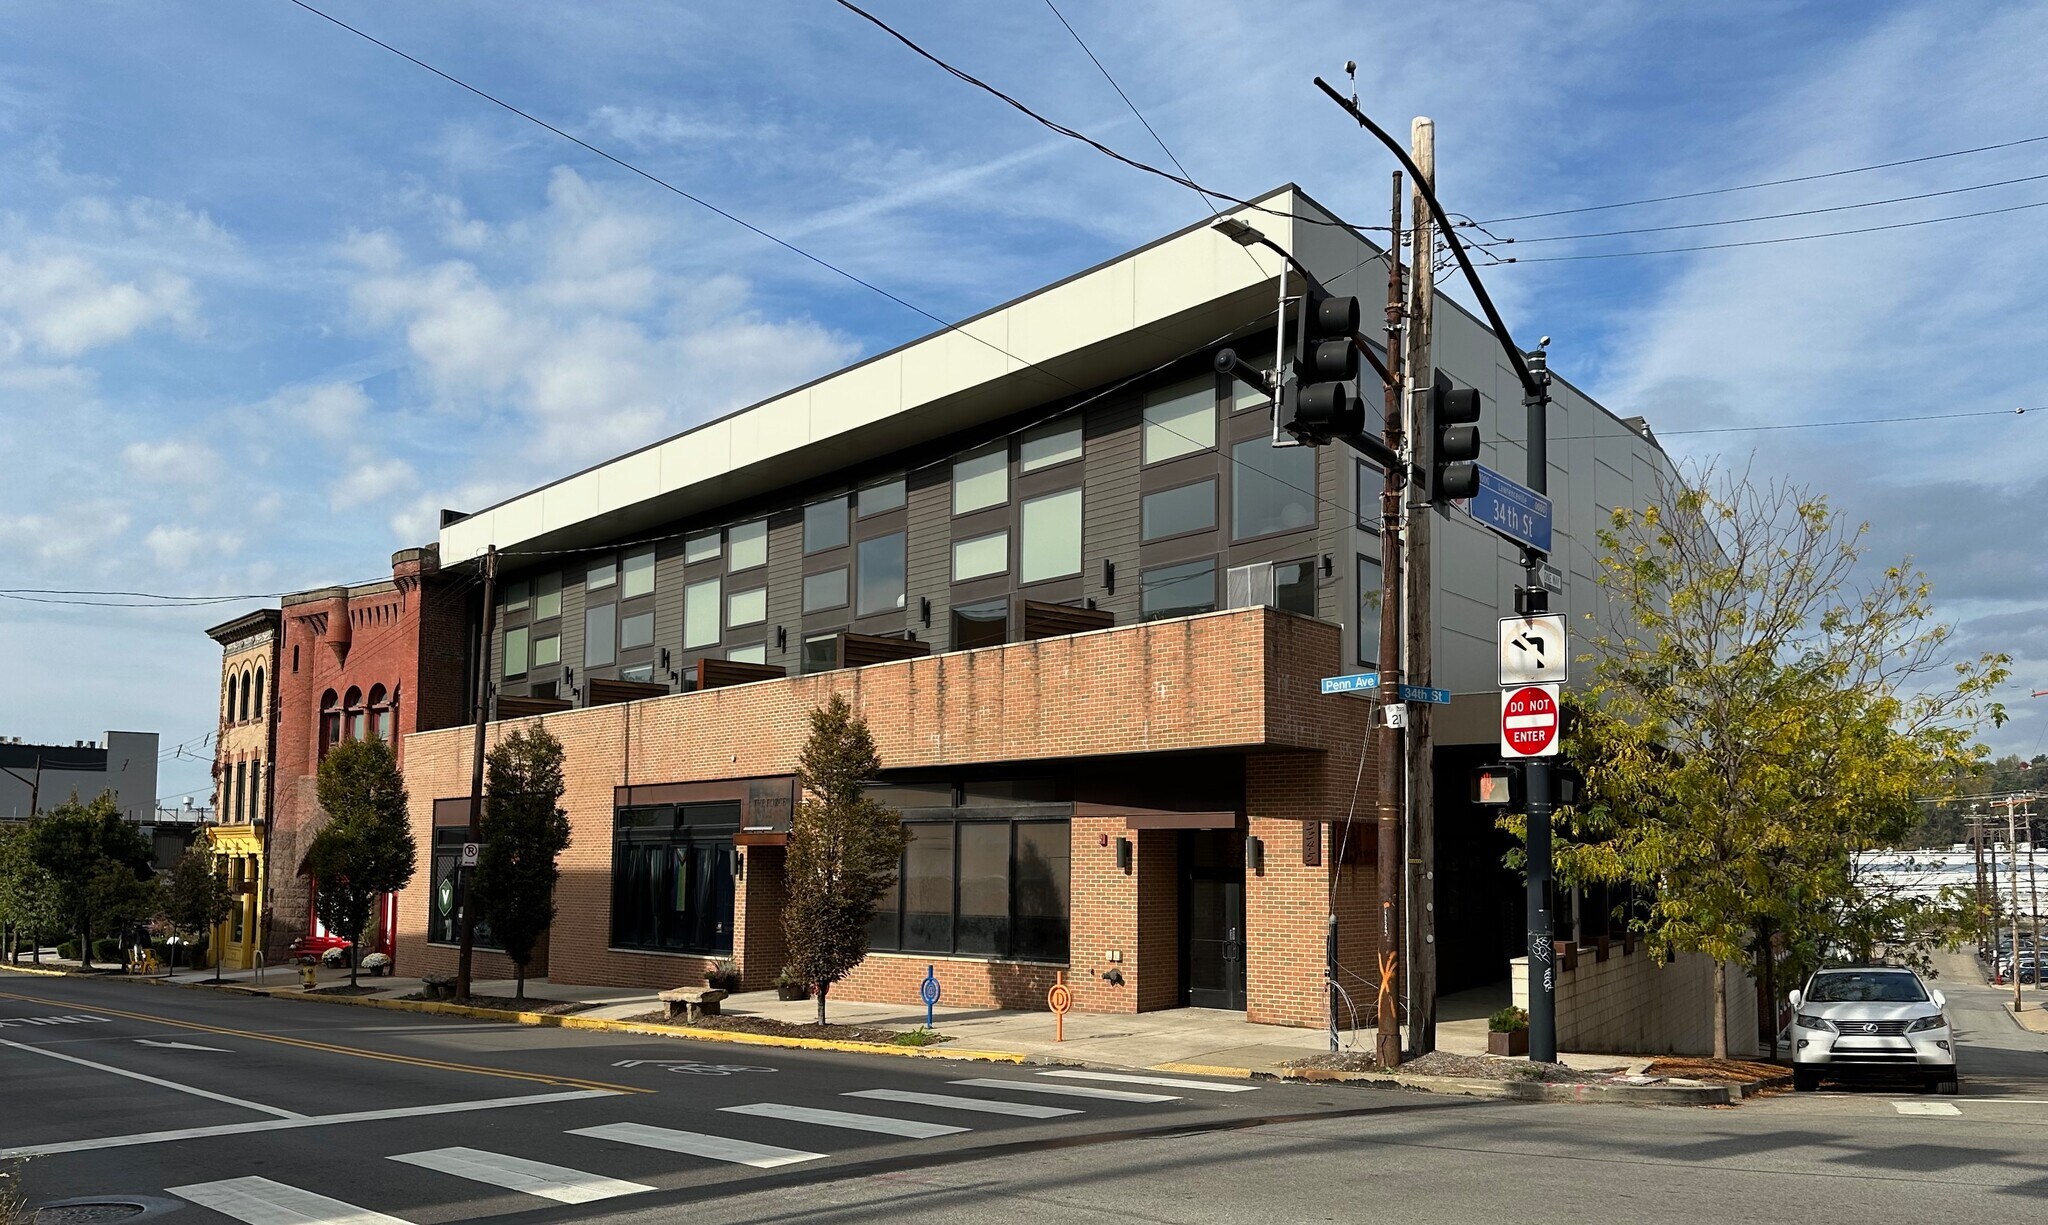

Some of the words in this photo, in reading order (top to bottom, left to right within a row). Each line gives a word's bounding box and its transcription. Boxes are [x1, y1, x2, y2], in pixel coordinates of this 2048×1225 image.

[1498, 483, 1527, 505] Lawrenceville
[1493, 499, 1518, 531] 34th
[1523, 514, 1533, 538] St
[1326, 680, 1352, 691] Penn
[1355, 677, 1374, 688] Ave
[1404, 687, 1427, 700] 34th
[1431, 690, 1442, 702] St
[1510, 701, 1524, 713] DO
[1530, 699, 1550, 711] NOT
[1392, 714, 1402, 725] 21
[1514, 730, 1546, 743] ENTER
